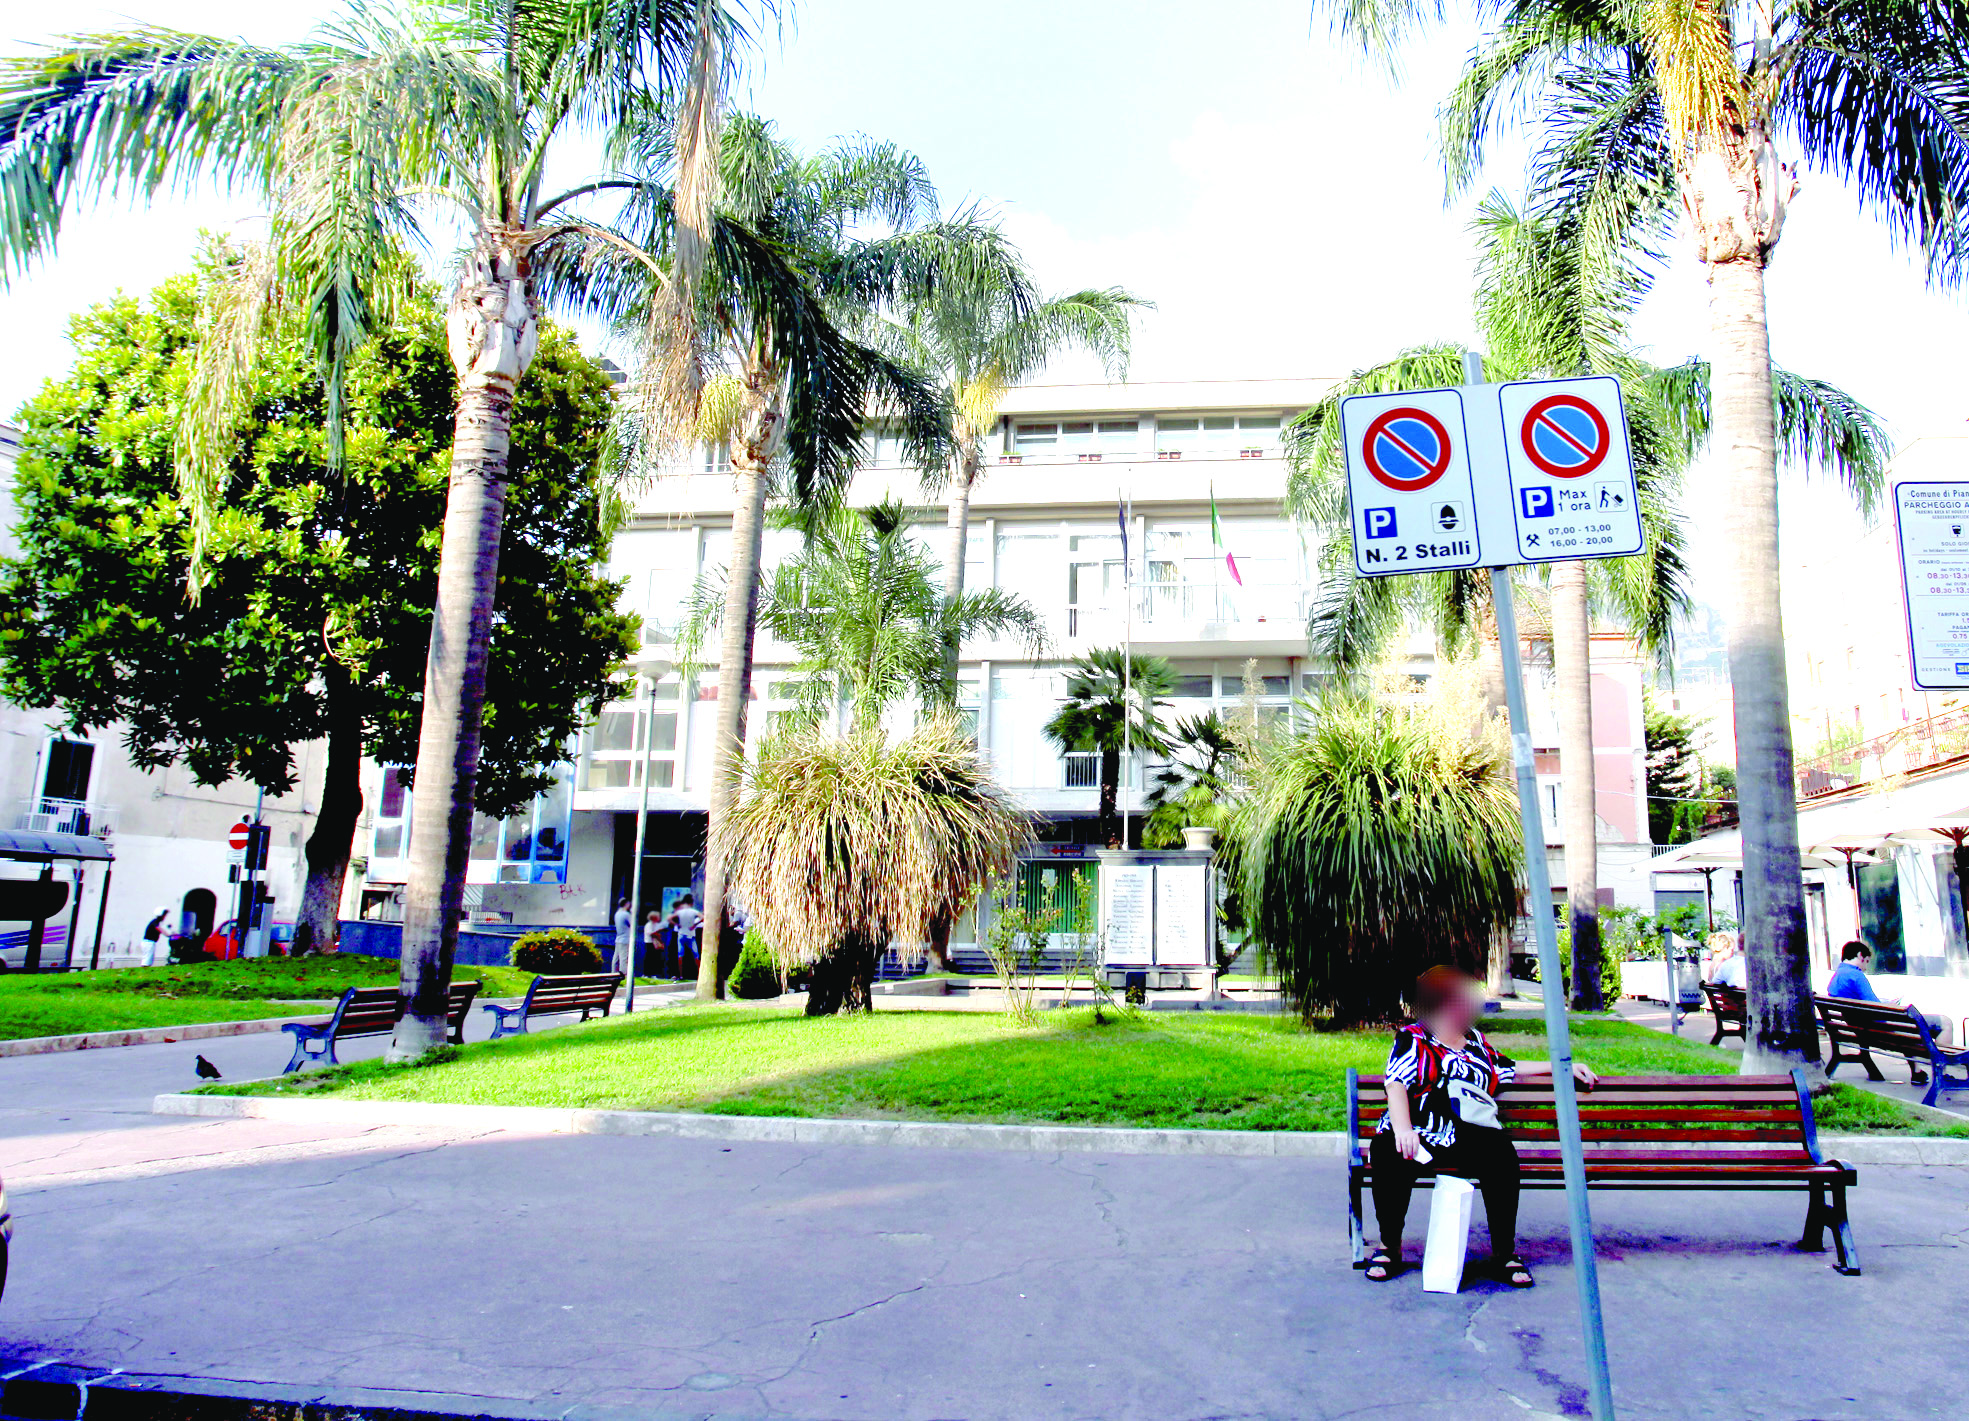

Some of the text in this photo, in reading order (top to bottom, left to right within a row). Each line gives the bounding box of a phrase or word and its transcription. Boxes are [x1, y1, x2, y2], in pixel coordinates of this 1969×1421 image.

[1559, 490, 1587, 500] Max
[1910, 490, 1940, 498] Comune
[1943, 490, 1950, 498] di
[1558, 502, 1591, 512] 1 ora
[1548, 527, 1575, 535] 07,00
[1585, 524, 1611, 533] 13,00
[1550, 539, 1577, 547] 16,00
[1586, 536, 1613, 545] 20,00
[1366, 540, 1470, 563] N. 2 Stalli
